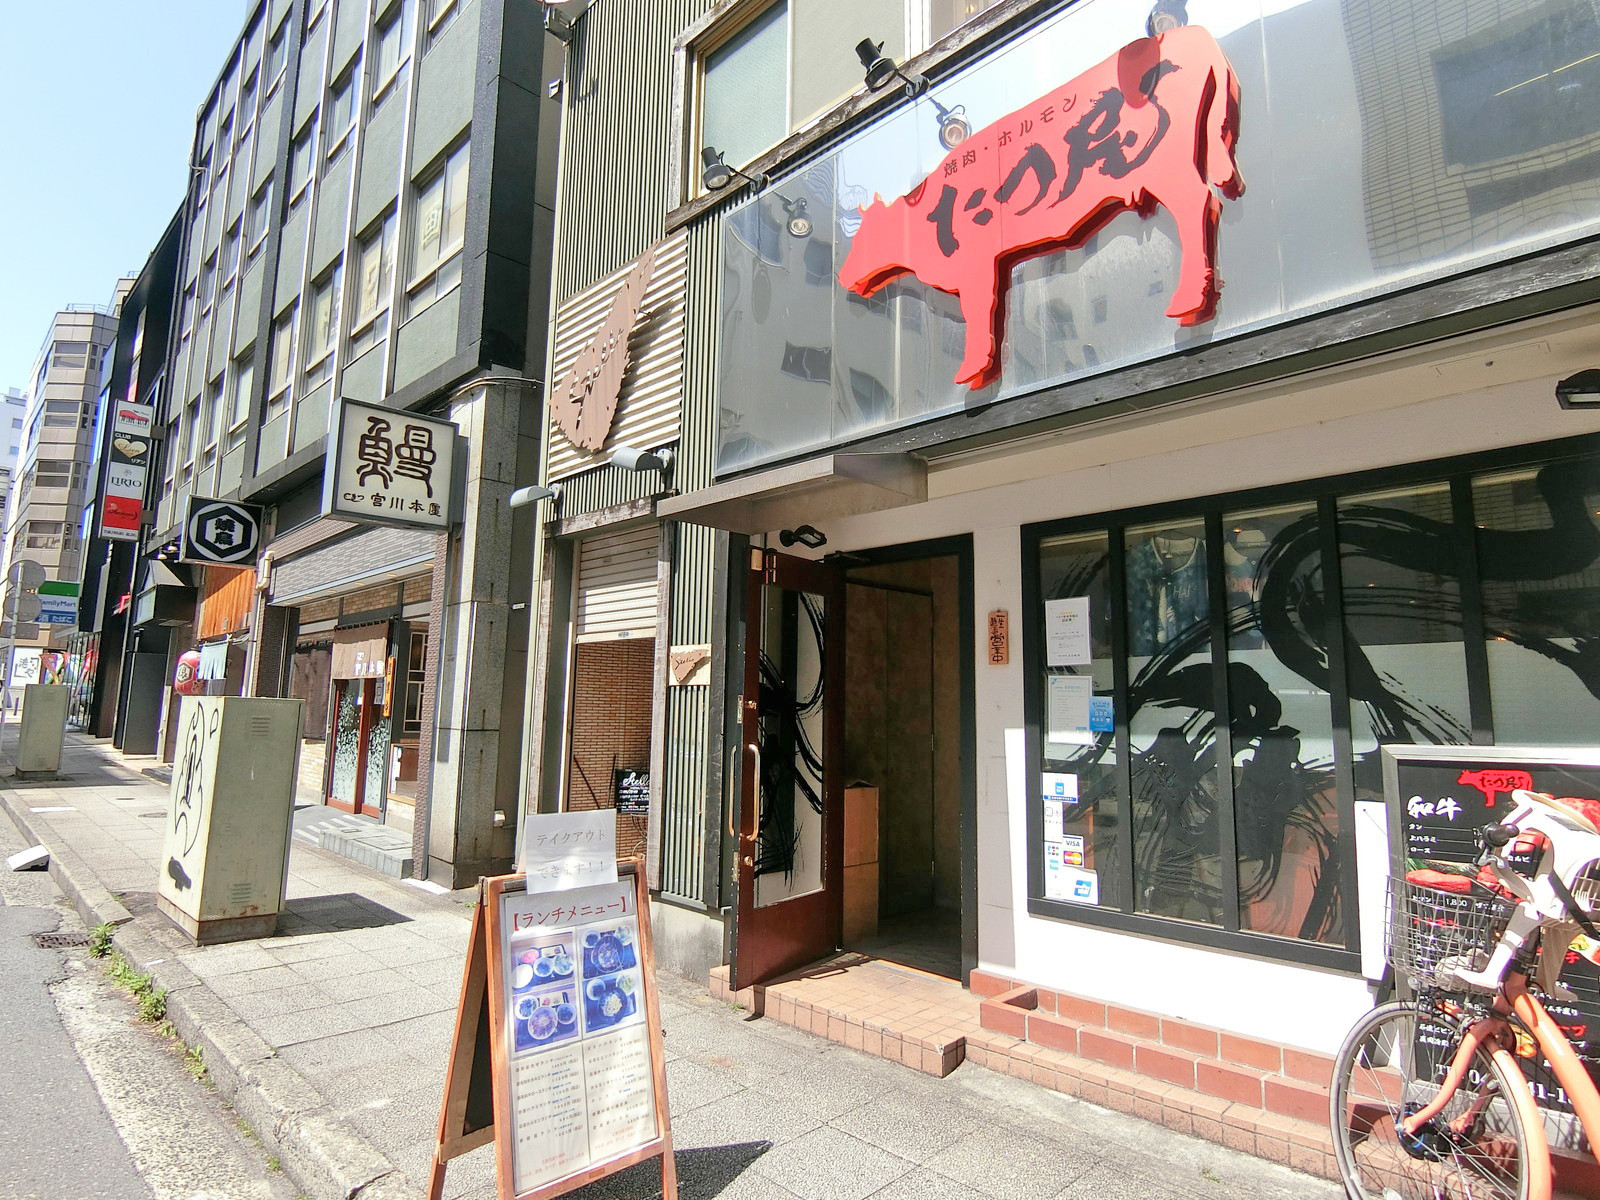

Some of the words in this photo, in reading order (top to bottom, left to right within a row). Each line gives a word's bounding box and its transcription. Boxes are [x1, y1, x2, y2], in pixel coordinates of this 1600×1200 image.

[943, 94, 1078, 178] 焼肉・ホルモン
[927, 60, 1182, 257] たつ尾
[114, 432, 131, 440] CLUB
[356, 416, 437, 499] 鰻
[41, 600, 77, 608] amilyMart
[52, 615, 73, 624] たばこ
[1407, 795, 1463, 822] 和牛
[1408, 823, 1423, 831] タン
[536, 829, 606, 847] テイクアウト
[1409, 834, 1437, 844] 上ハラミ
[1065, 839, 1081, 847] VISA
[1410, 846, 1431, 854] ロース
